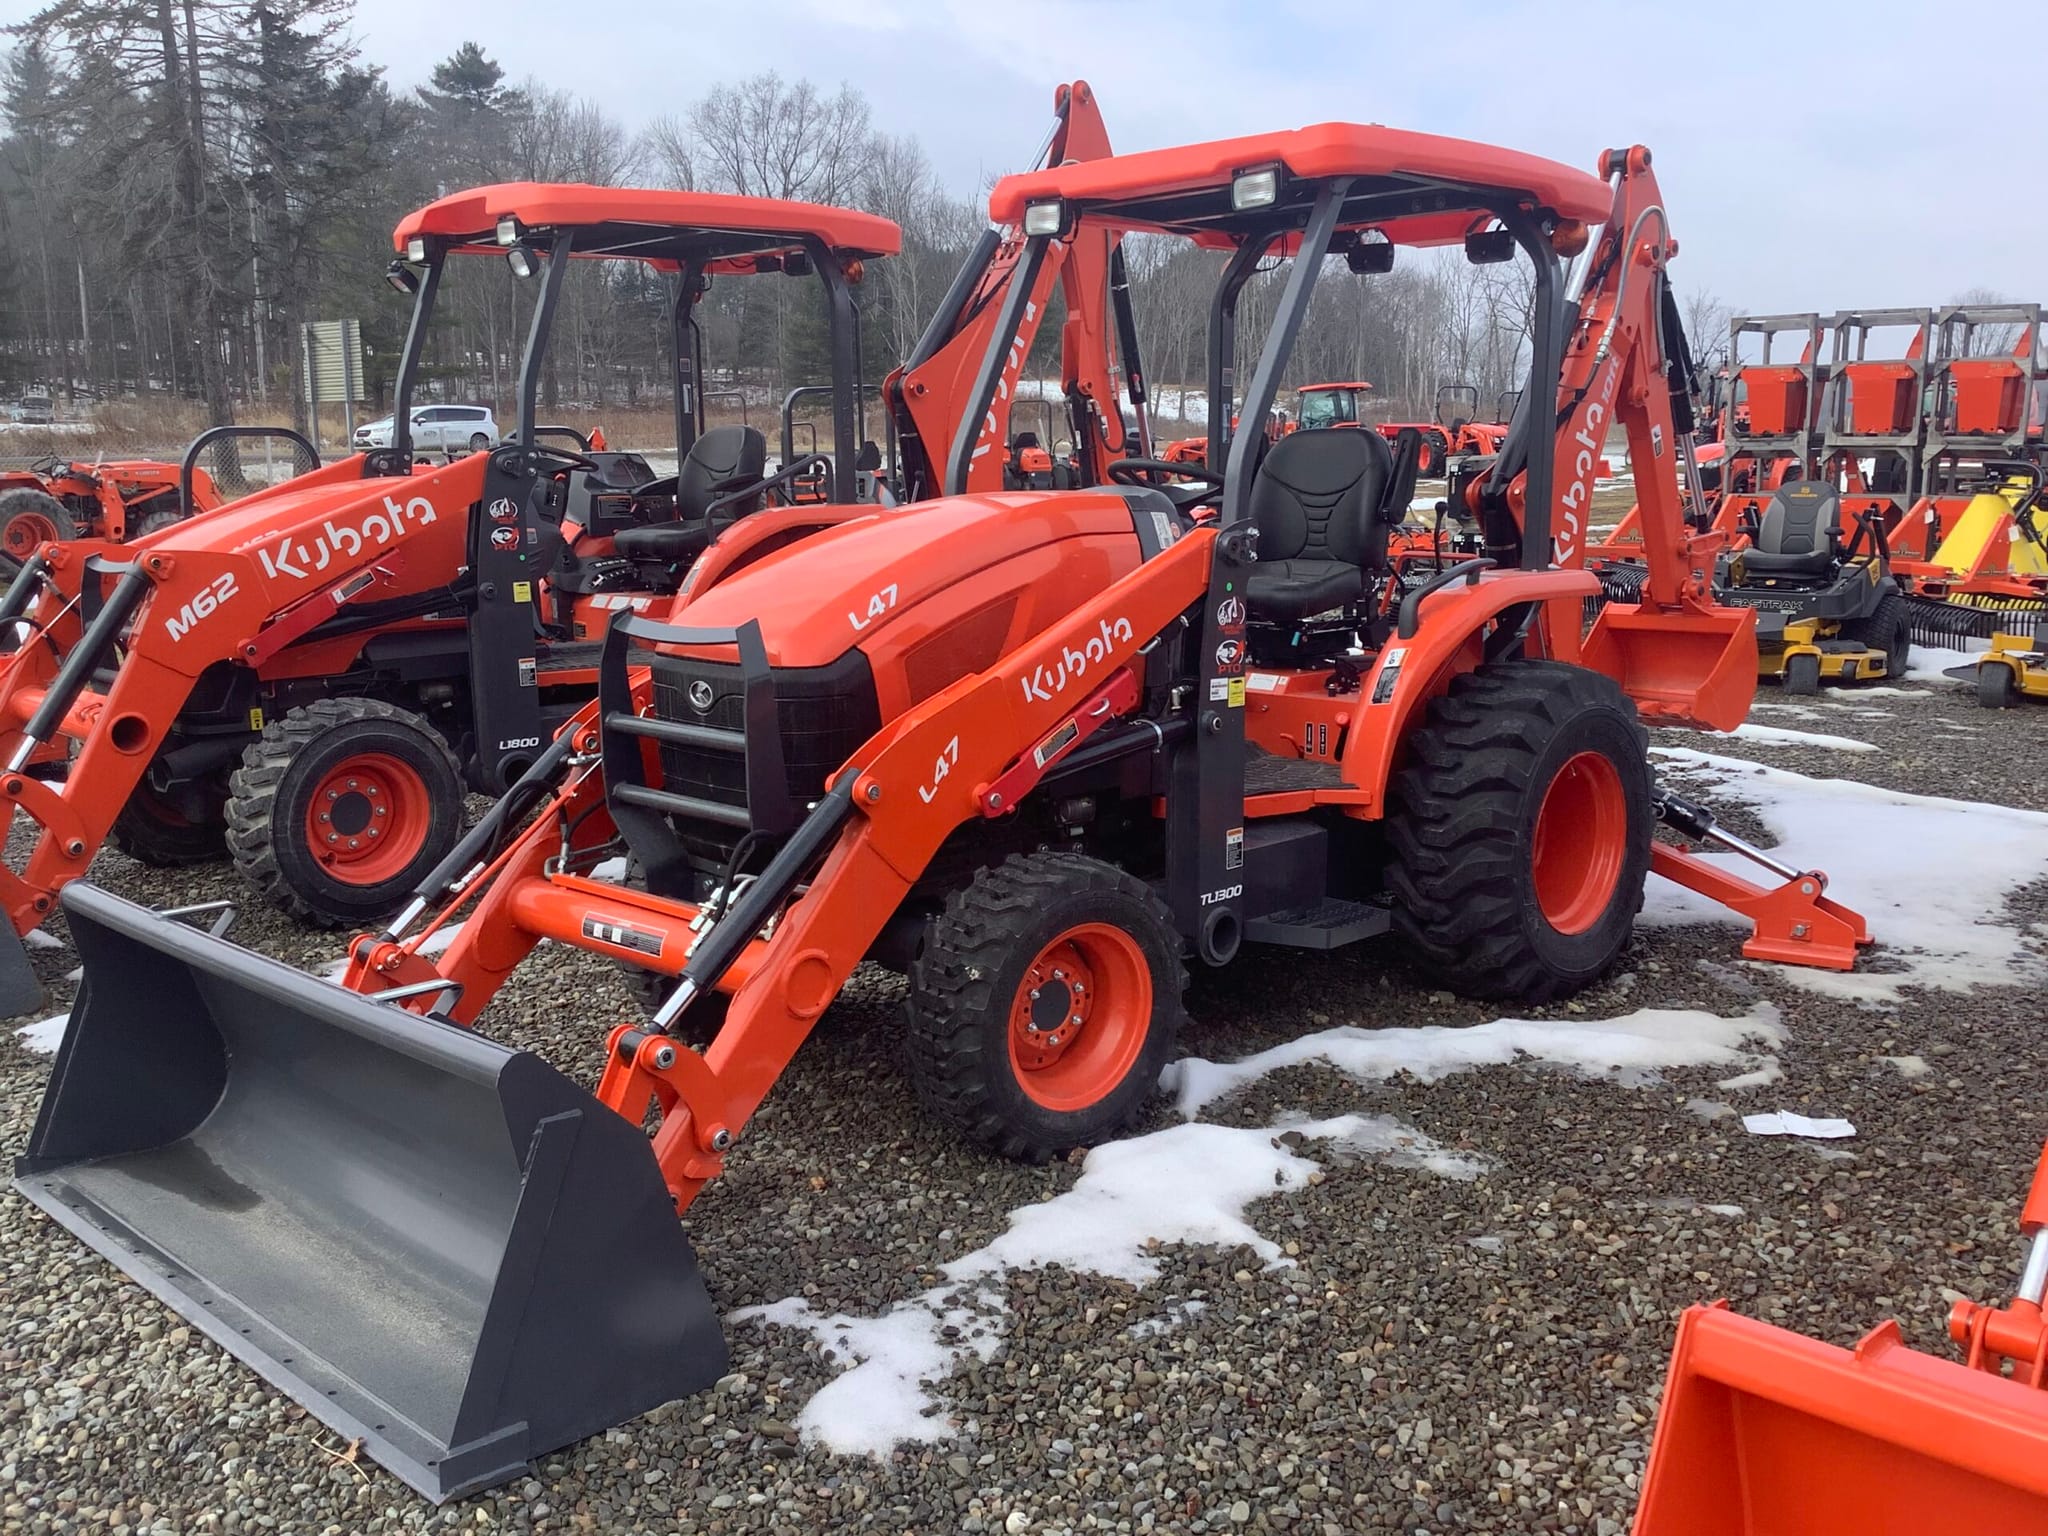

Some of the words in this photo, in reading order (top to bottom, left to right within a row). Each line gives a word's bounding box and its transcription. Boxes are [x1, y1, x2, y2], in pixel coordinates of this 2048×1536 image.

[1548, 402, 1604, 569] Kubota
[257, 496, 437, 578] Kubota
[164, 572, 240, 642] M62
[848, 583, 898, 631] L47
[1730, 598, 1804, 611] FASTRAK
[1021, 617, 1134, 704] Kubota
[1218, 663, 1241, 674] PTO
[499, 737, 540, 750] L1800
[919, 735, 959, 804] L47
[1200, 884, 1243, 906] TL1300
